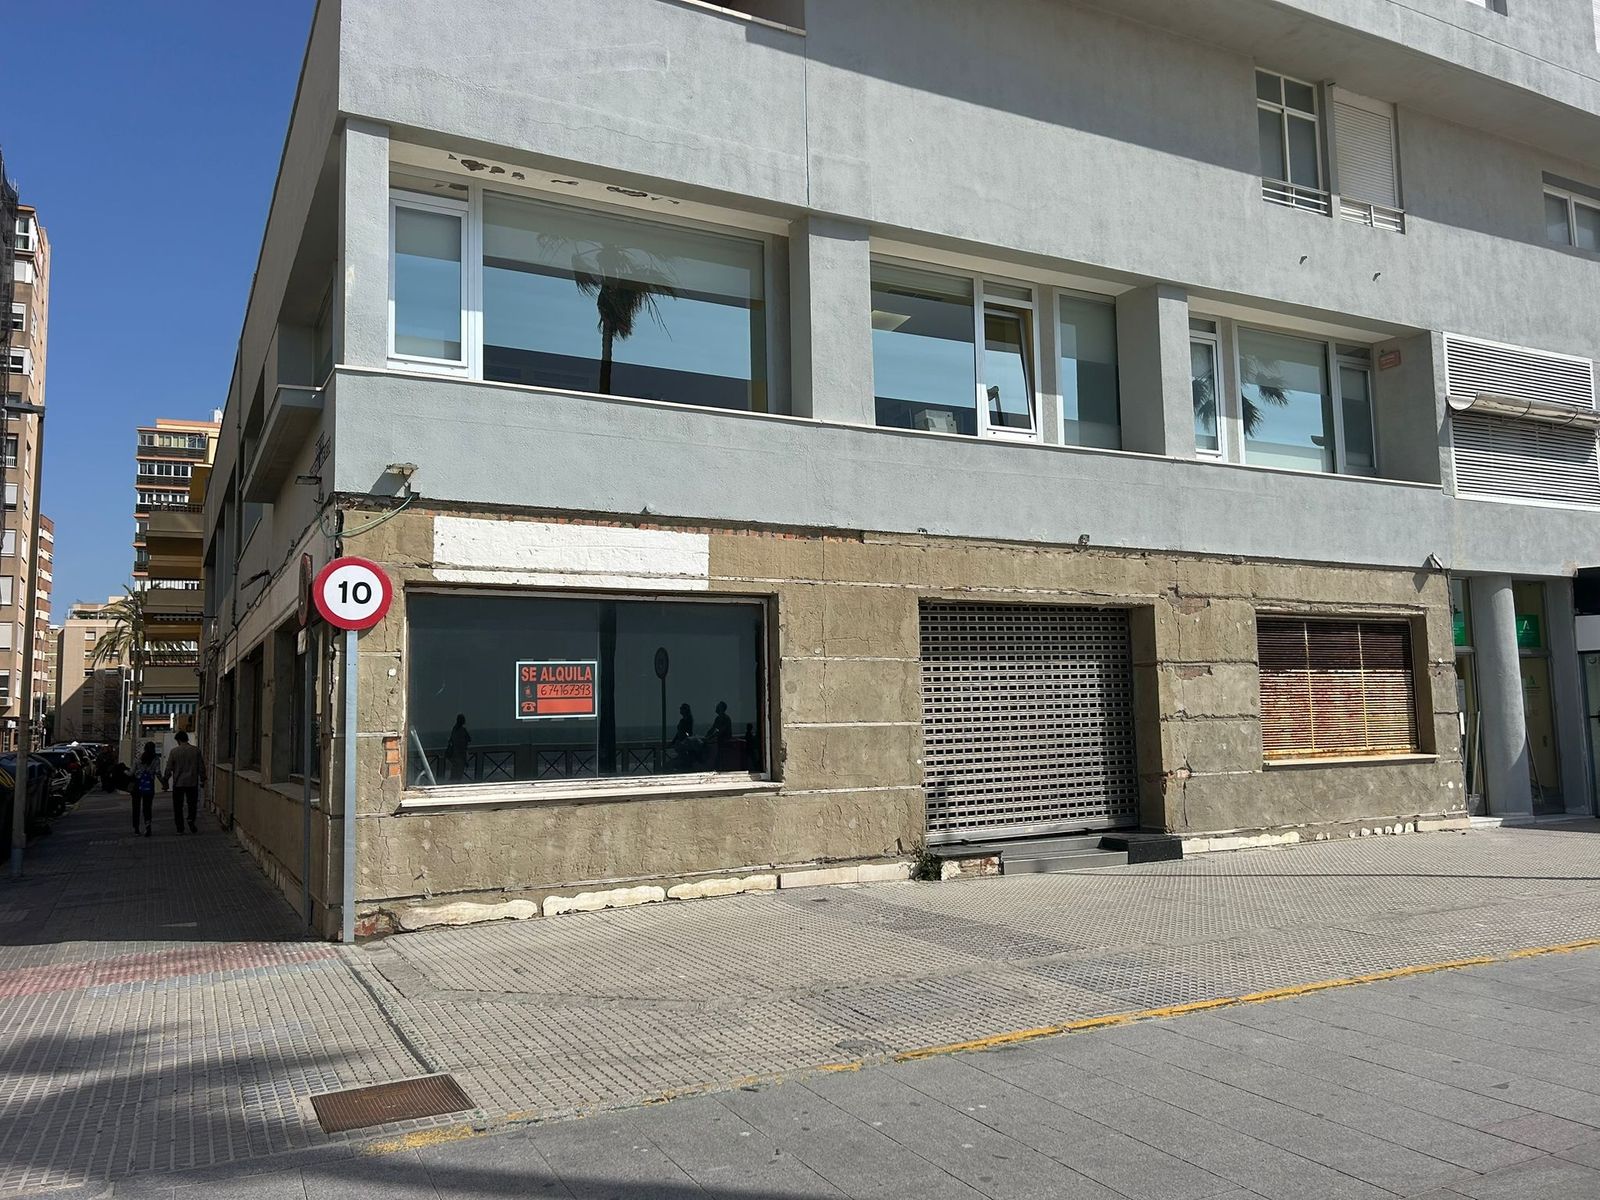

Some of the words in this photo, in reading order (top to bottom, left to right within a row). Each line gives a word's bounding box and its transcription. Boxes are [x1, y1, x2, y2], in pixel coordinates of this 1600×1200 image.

[338, 581, 372, 604] 10
[521, 666, 537, 681] SE
[540, 666, 592, 682] ALQUILA
[540, 684, 591, 696] 674167393
